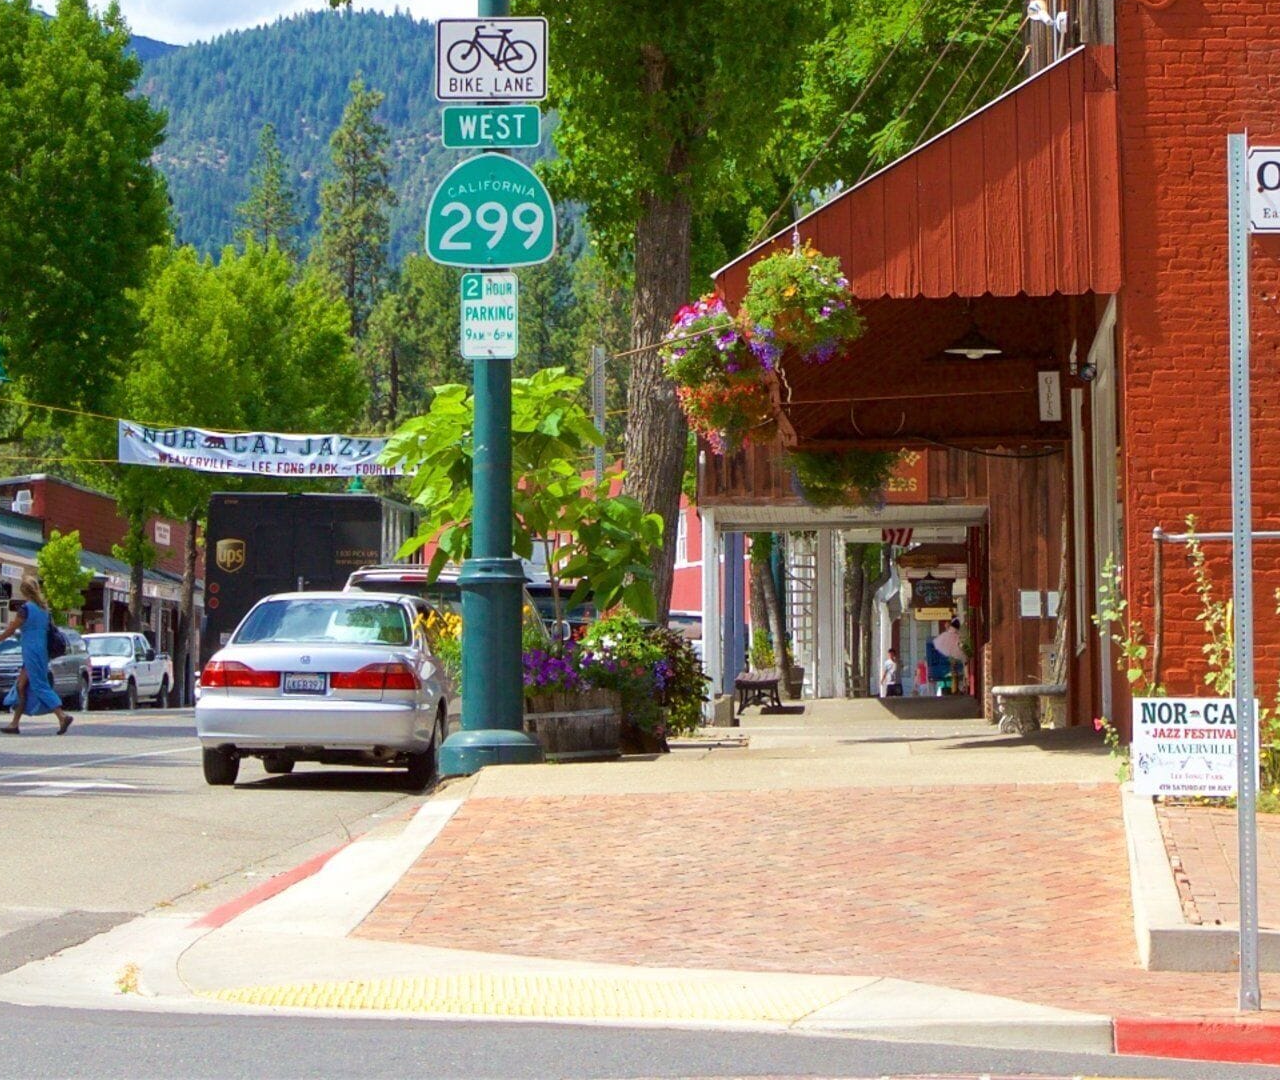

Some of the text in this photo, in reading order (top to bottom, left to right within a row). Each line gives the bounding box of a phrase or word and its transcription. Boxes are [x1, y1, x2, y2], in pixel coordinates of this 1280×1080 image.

[449, 77, 533, 92] BIKE LANE
[459, 114, 525, 139] WEST
[448, 180, 535, 198] CALIFORNIA
[439, 201, 544, 250] 299
[466, 278, 513, 297] 2 HOUR
[465, 306, 514, 321] PARKING
[465, 327, 513, 341] 9AM 6PM
[143, 427, 371, 457] NOR CAL JAZZ
[158, 451, 233, 470] WEAVERVILLE
[251, 461, 273, 473] LEE
[277, 462, 304, 474] FONG
[310, 463, 338, 474] PARK
[218, 548, 243, 568] ups
[1141, 703, 1236, 724] NOR CA
[1152, 728, 1181, 739] JAZZ
[1157, 744, 1233, 755] WEAVERVILLE
